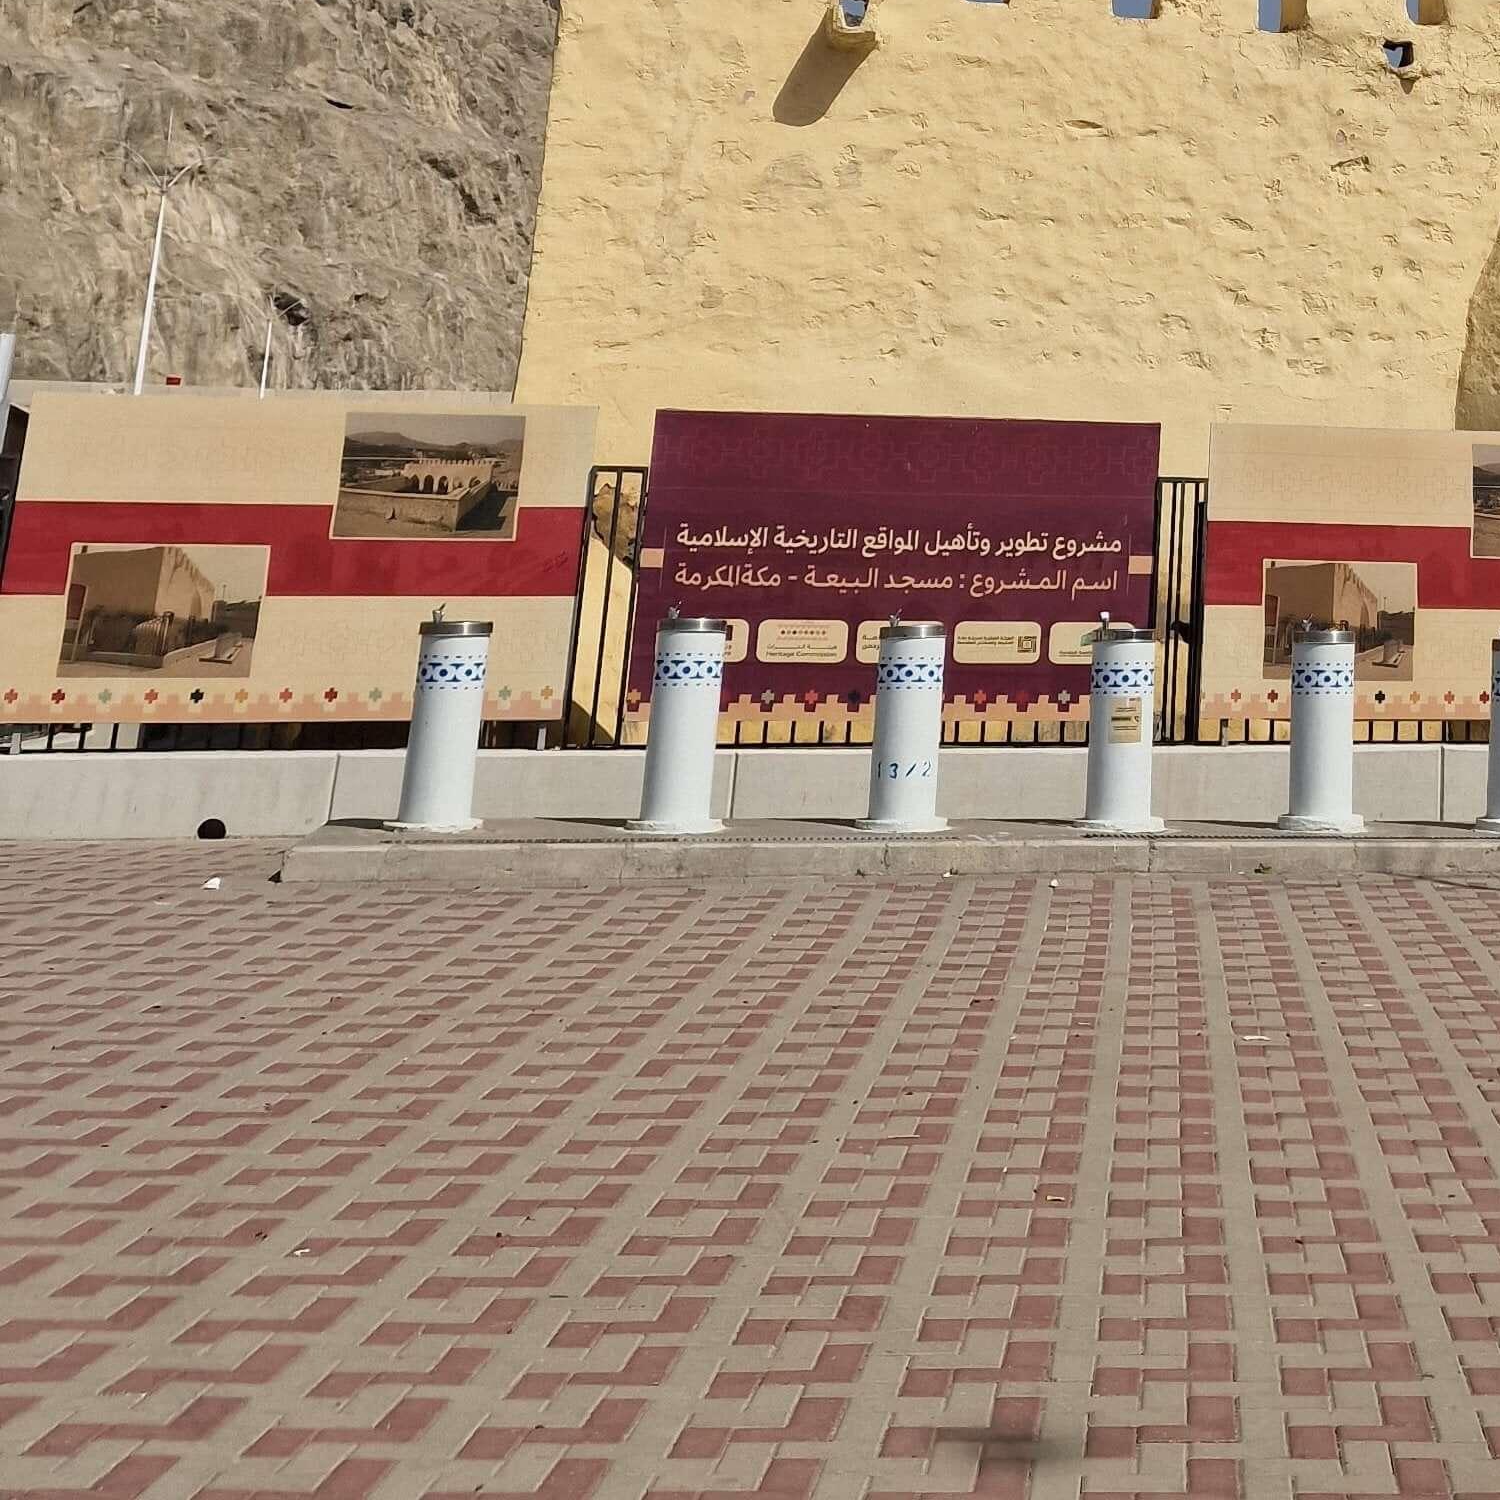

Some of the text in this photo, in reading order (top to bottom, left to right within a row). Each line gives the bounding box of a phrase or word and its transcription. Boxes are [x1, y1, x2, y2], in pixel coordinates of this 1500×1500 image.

[676, 522, 1122, 560] مشروع تطوير وتأهيل المواقع التاريخية الإسلامية
[804, 564, 880, 594] البيعة
[884, 574, 953, 594] مسجد
[969, 568, 1067, 598] المشروع
[1071, 570, 1118, 600] اسم
